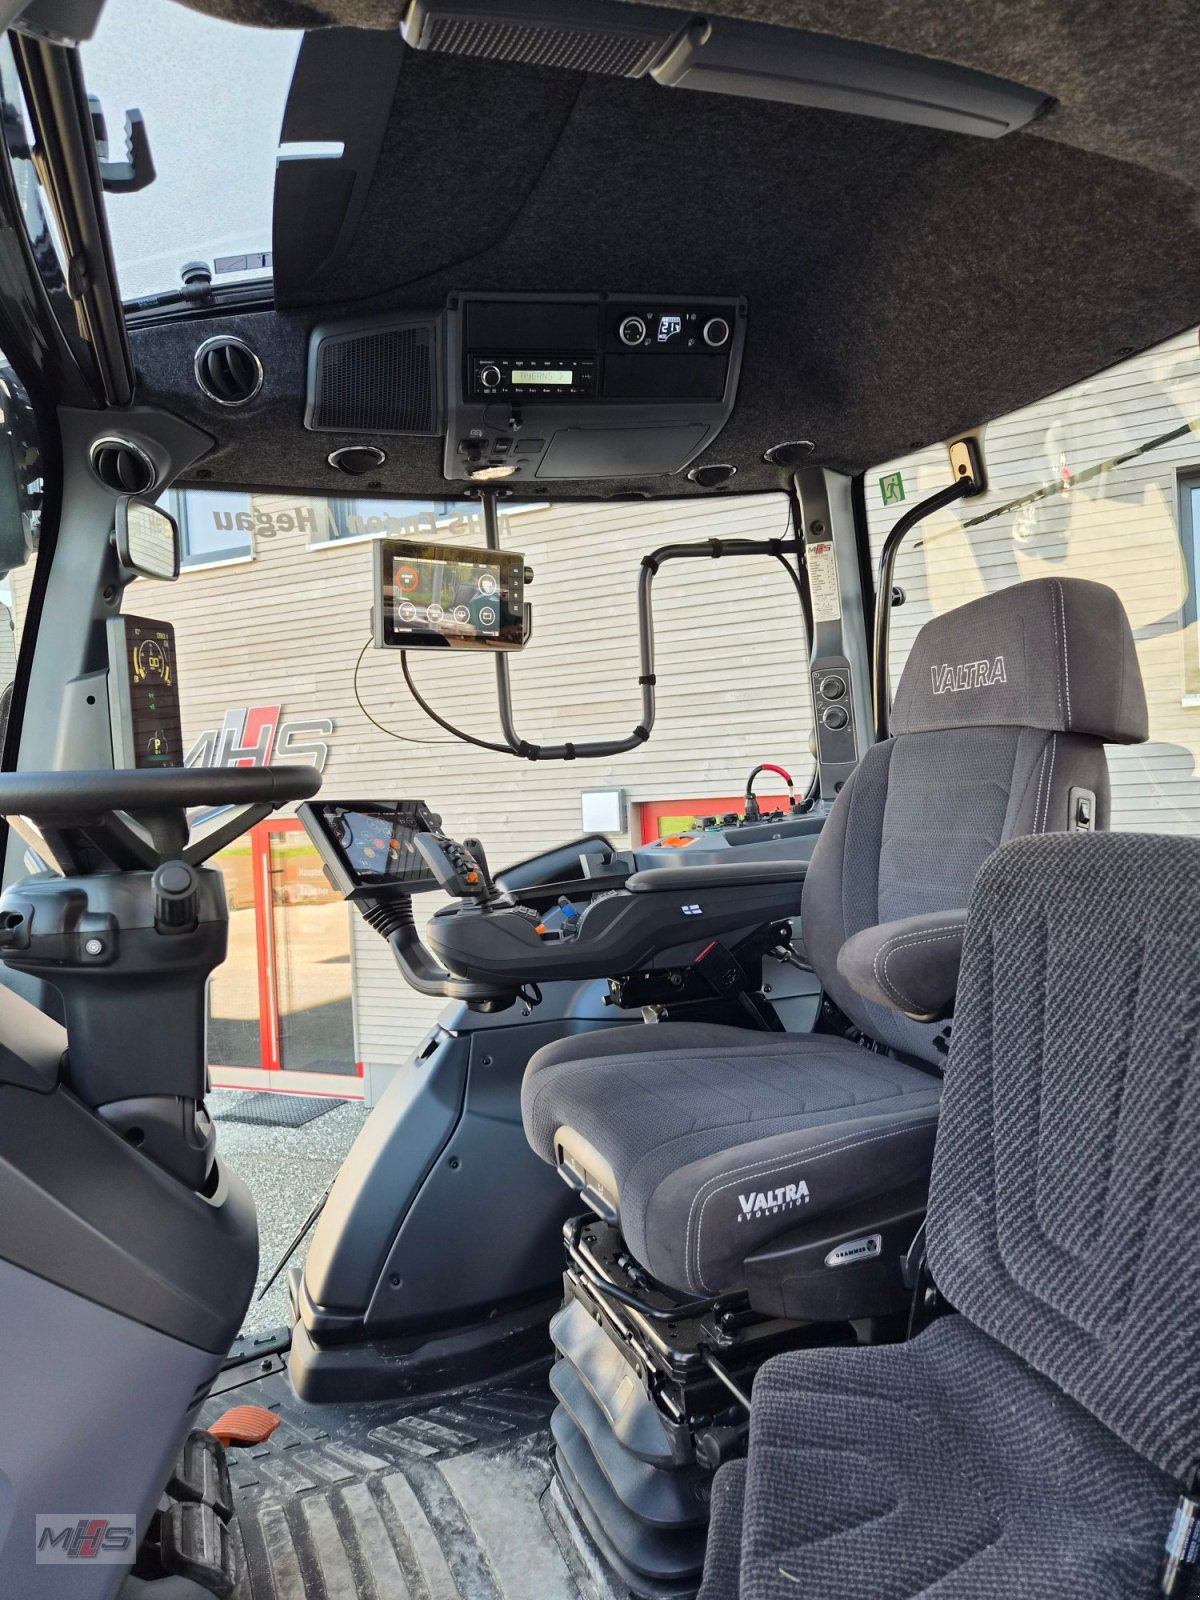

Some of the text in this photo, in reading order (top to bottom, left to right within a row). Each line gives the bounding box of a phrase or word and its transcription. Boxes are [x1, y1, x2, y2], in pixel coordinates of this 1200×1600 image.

[930, 655, 1007, 694] VALTRA
[737, 1195, 810, 1222] EVOLUTION
[738, 1180, 810, 1214] VALTRA
